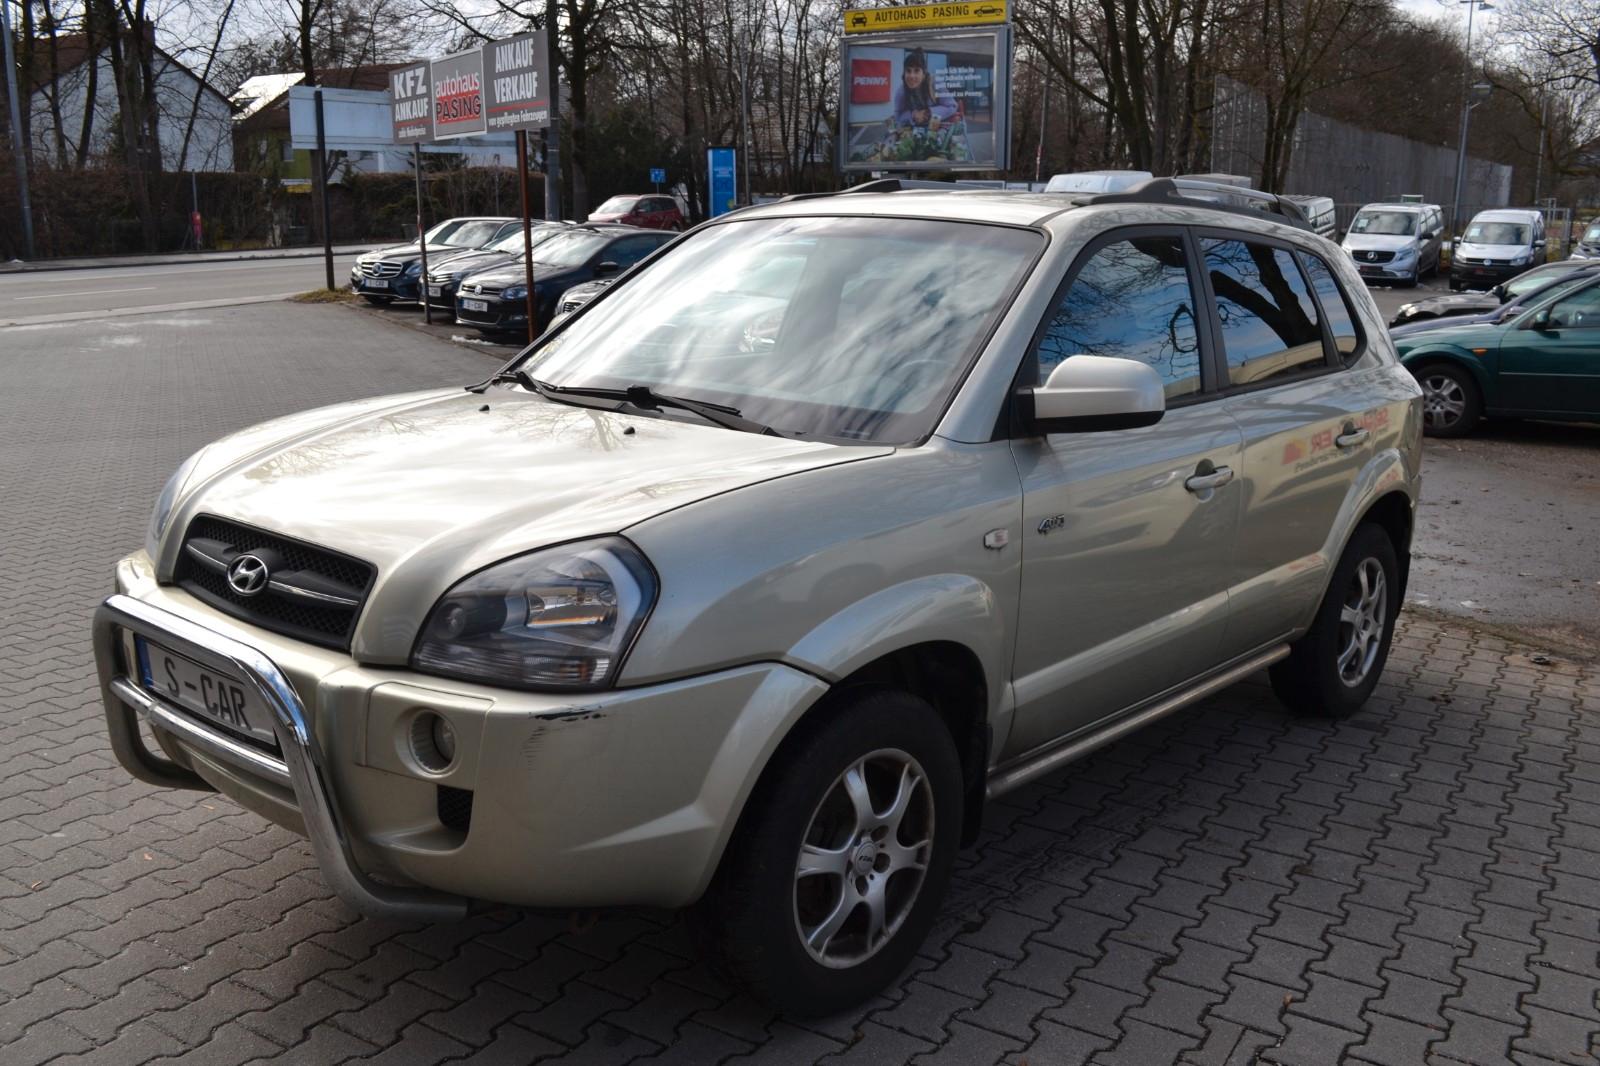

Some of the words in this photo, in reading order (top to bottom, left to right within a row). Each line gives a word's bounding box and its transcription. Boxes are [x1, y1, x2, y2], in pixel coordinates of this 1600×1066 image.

[874, 8, 926, 23] AUTOHAUS
[933, 5, 969, 18] PASING
[495, 38, 534, 73] ANKAUF
[394, 67, 428, 100] KFZ
[435, 70, 481, 97] autohaus
[494, 72, 537, 105] VERKAUF
[395, 97, 429, 122] ANKAUF
[436, 94, 482, 121] PASING
